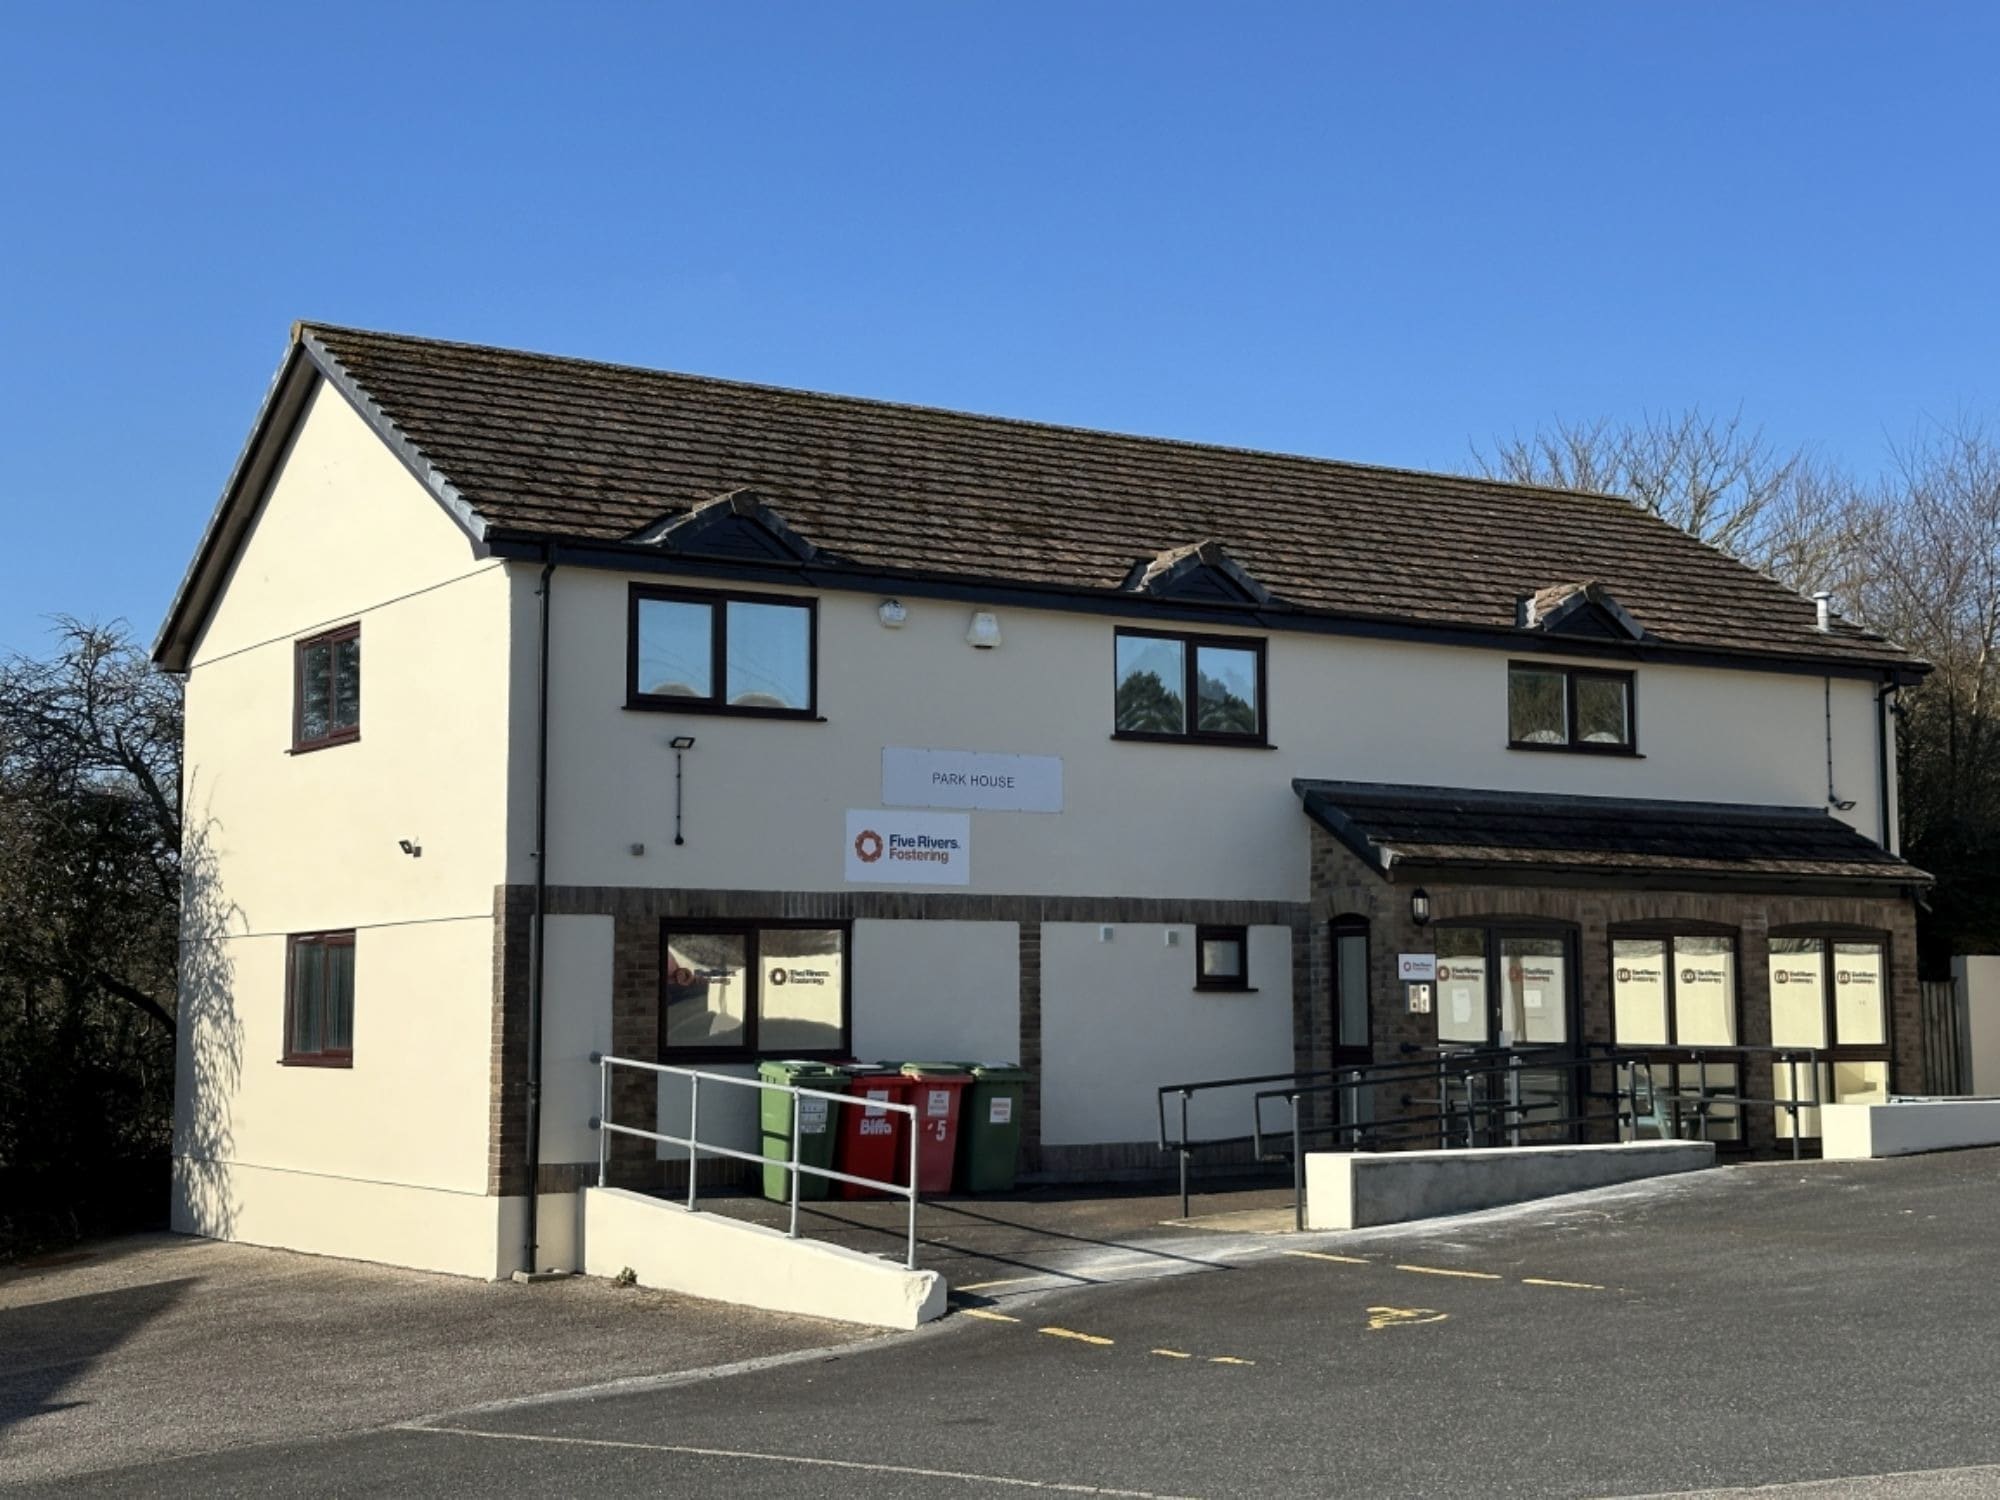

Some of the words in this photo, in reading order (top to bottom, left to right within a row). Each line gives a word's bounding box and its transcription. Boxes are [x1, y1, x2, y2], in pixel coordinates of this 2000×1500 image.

[932, 772, 967, 786] PARK
[970, 775, 1015, 789] HOUSE
[889, 834, 916, 847] Five
[889, 848, 949, 864] Fostering
[935, 1120, 947, 1141] 5
